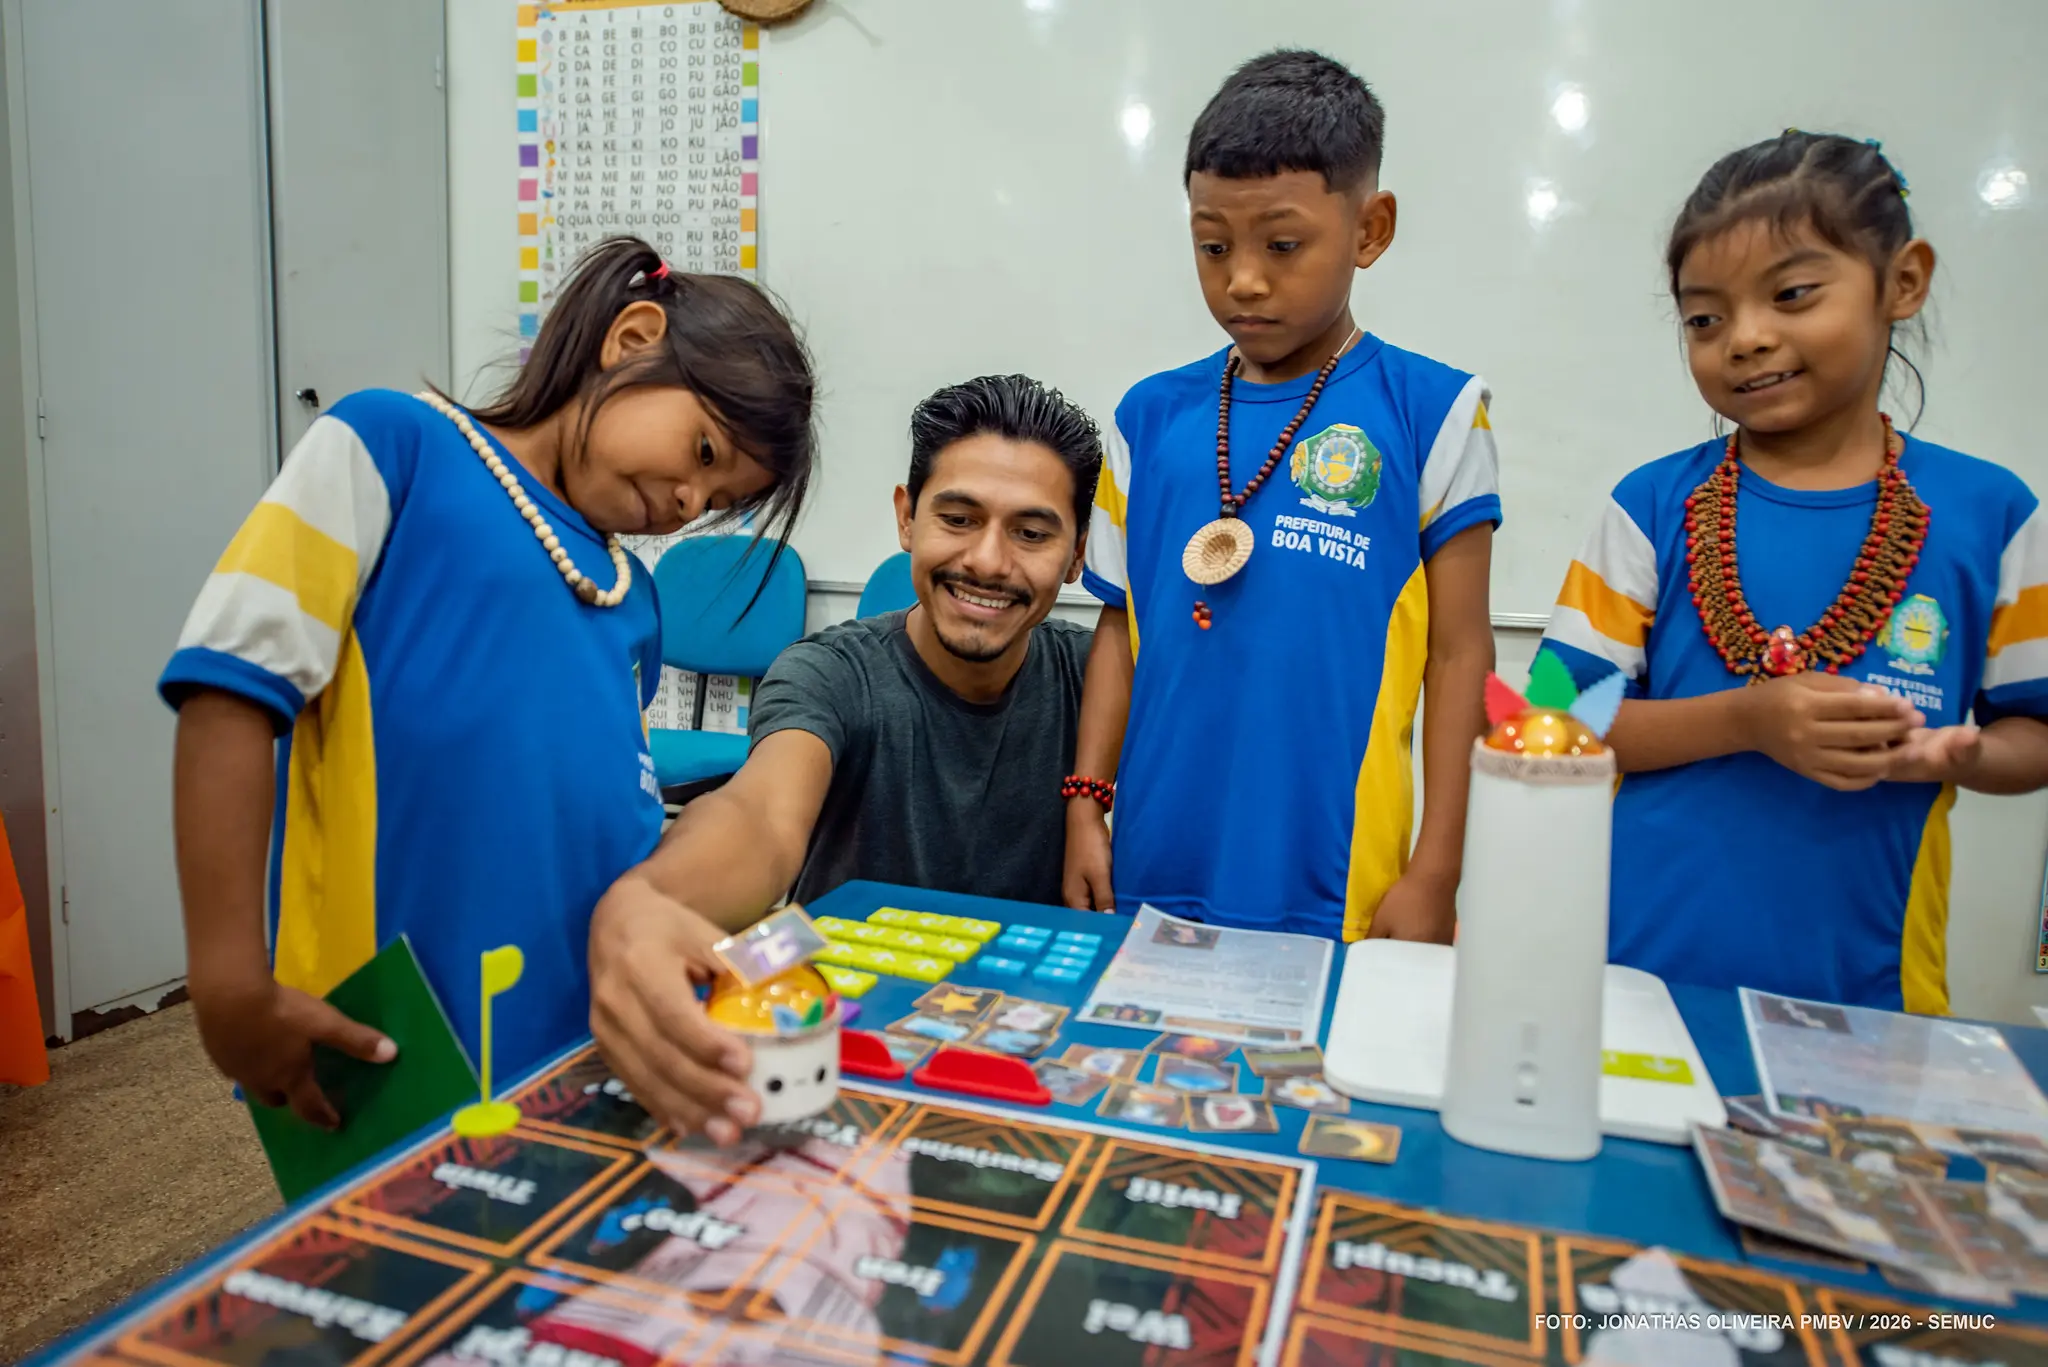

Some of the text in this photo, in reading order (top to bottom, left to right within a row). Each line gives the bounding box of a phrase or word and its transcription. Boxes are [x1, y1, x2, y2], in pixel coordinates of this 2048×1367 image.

[575, 30, 591, 42] BA
[603, 28, 616, 41] BE
[631, 27, 643, 39] BI
[659, 25, 677, 37] BO
[688, 23, 706, 35] BU
[574, 45, 590, 57] CA
[603, 44, 616, 57] CE
[631, 42, 643, 55] CI
[659, 40, 677, 53] CO
[688, 39, 705, 50] CU
[574, 60, 591, 72] DA
[602, 59, 616, 72] DE
[631, 58, 644, 70] DI
[659, 57, 678, 69] DO
[687, 55, 706, 67] DU
[575, 77, 590, 88] FA
[603, 75, 615, 87] FE
[632, 74, 643, 85] FI
[660, 73, 676, 85] FO
[689, 71, 704, 83] FU
[575, 93, 591, 104] GA
[601, 91, 616, 104] GE
[631, 90, 644, 102] GI
[658, 88, 677, 100] GO
[688, 87, 706, 99] GU
[576, 108, 593, 120] HA
[603, 108, 617, 120] HE
[632, 107, 644, 118] HI
[659, 104, 678, 117] HO
[688, 104, 706, 116] HU
[578, 122, 590, 136] JA
[604, 121, 615, 136] JE
[633, 120, 642, 134] JI
[660, 118, 675, 132] JO
[689, 118, 704, 132] JU
[577, 141, 592, 151] KA
[603, 140, 616, 151] KE
[631, 140, 643, 150] KI
[660, 137, 678, 149] KO
[688, 137, 705, 148] KU
[577, 155, 592, 167] LA
[604, 155, 617, 167] LE
[631, 155, 642, 167] LI
[660, 153, 677, 166] LO
[689, 153, 705, 164] LU
[574, 171, 593, 182] MA
[601, 171, 618, 182] ME
[630, 171, 645, 182] MI
[658, 170, 678, 181] MO
[688, 169, 708, 180] MU
[573, 186, 590, 195] NA
[600, 186, 616, 197] NE
[630, 185, 643, 195] NI
[656, 184, 676, 195] NO
[687, 184, 706, 194] NU
[574, 200, 589, 211] PA
[601, 200, 615, 212] PE
[630, 199, 641, 210] PI
[657, 199, 674, 210] PO
[688, 199, 704, 210] PU
[567, 214, 593, 226] QUA
[596, 213, 620, 226] QUE
[625, 214, 647, 226] QUI
[652, 213, 681, 225] QUO
[574, 232, 589, 242] RA
[656, 231, 674, 243] RO
[687, 231, 703, 242] RU
[687, 245, 702, 257] SU
[1275, 515, 1371, 550] PREFEITURA DE
[1272, 530, 1366, 570] BOA VISTA
[710, 676, 733, 687] CHU
[678, 686, 694, 696] NH
[709, 690, 734, 700] NHU
[678, 700, 694, 709] LH
[710, 703, 732, 713] LHU
